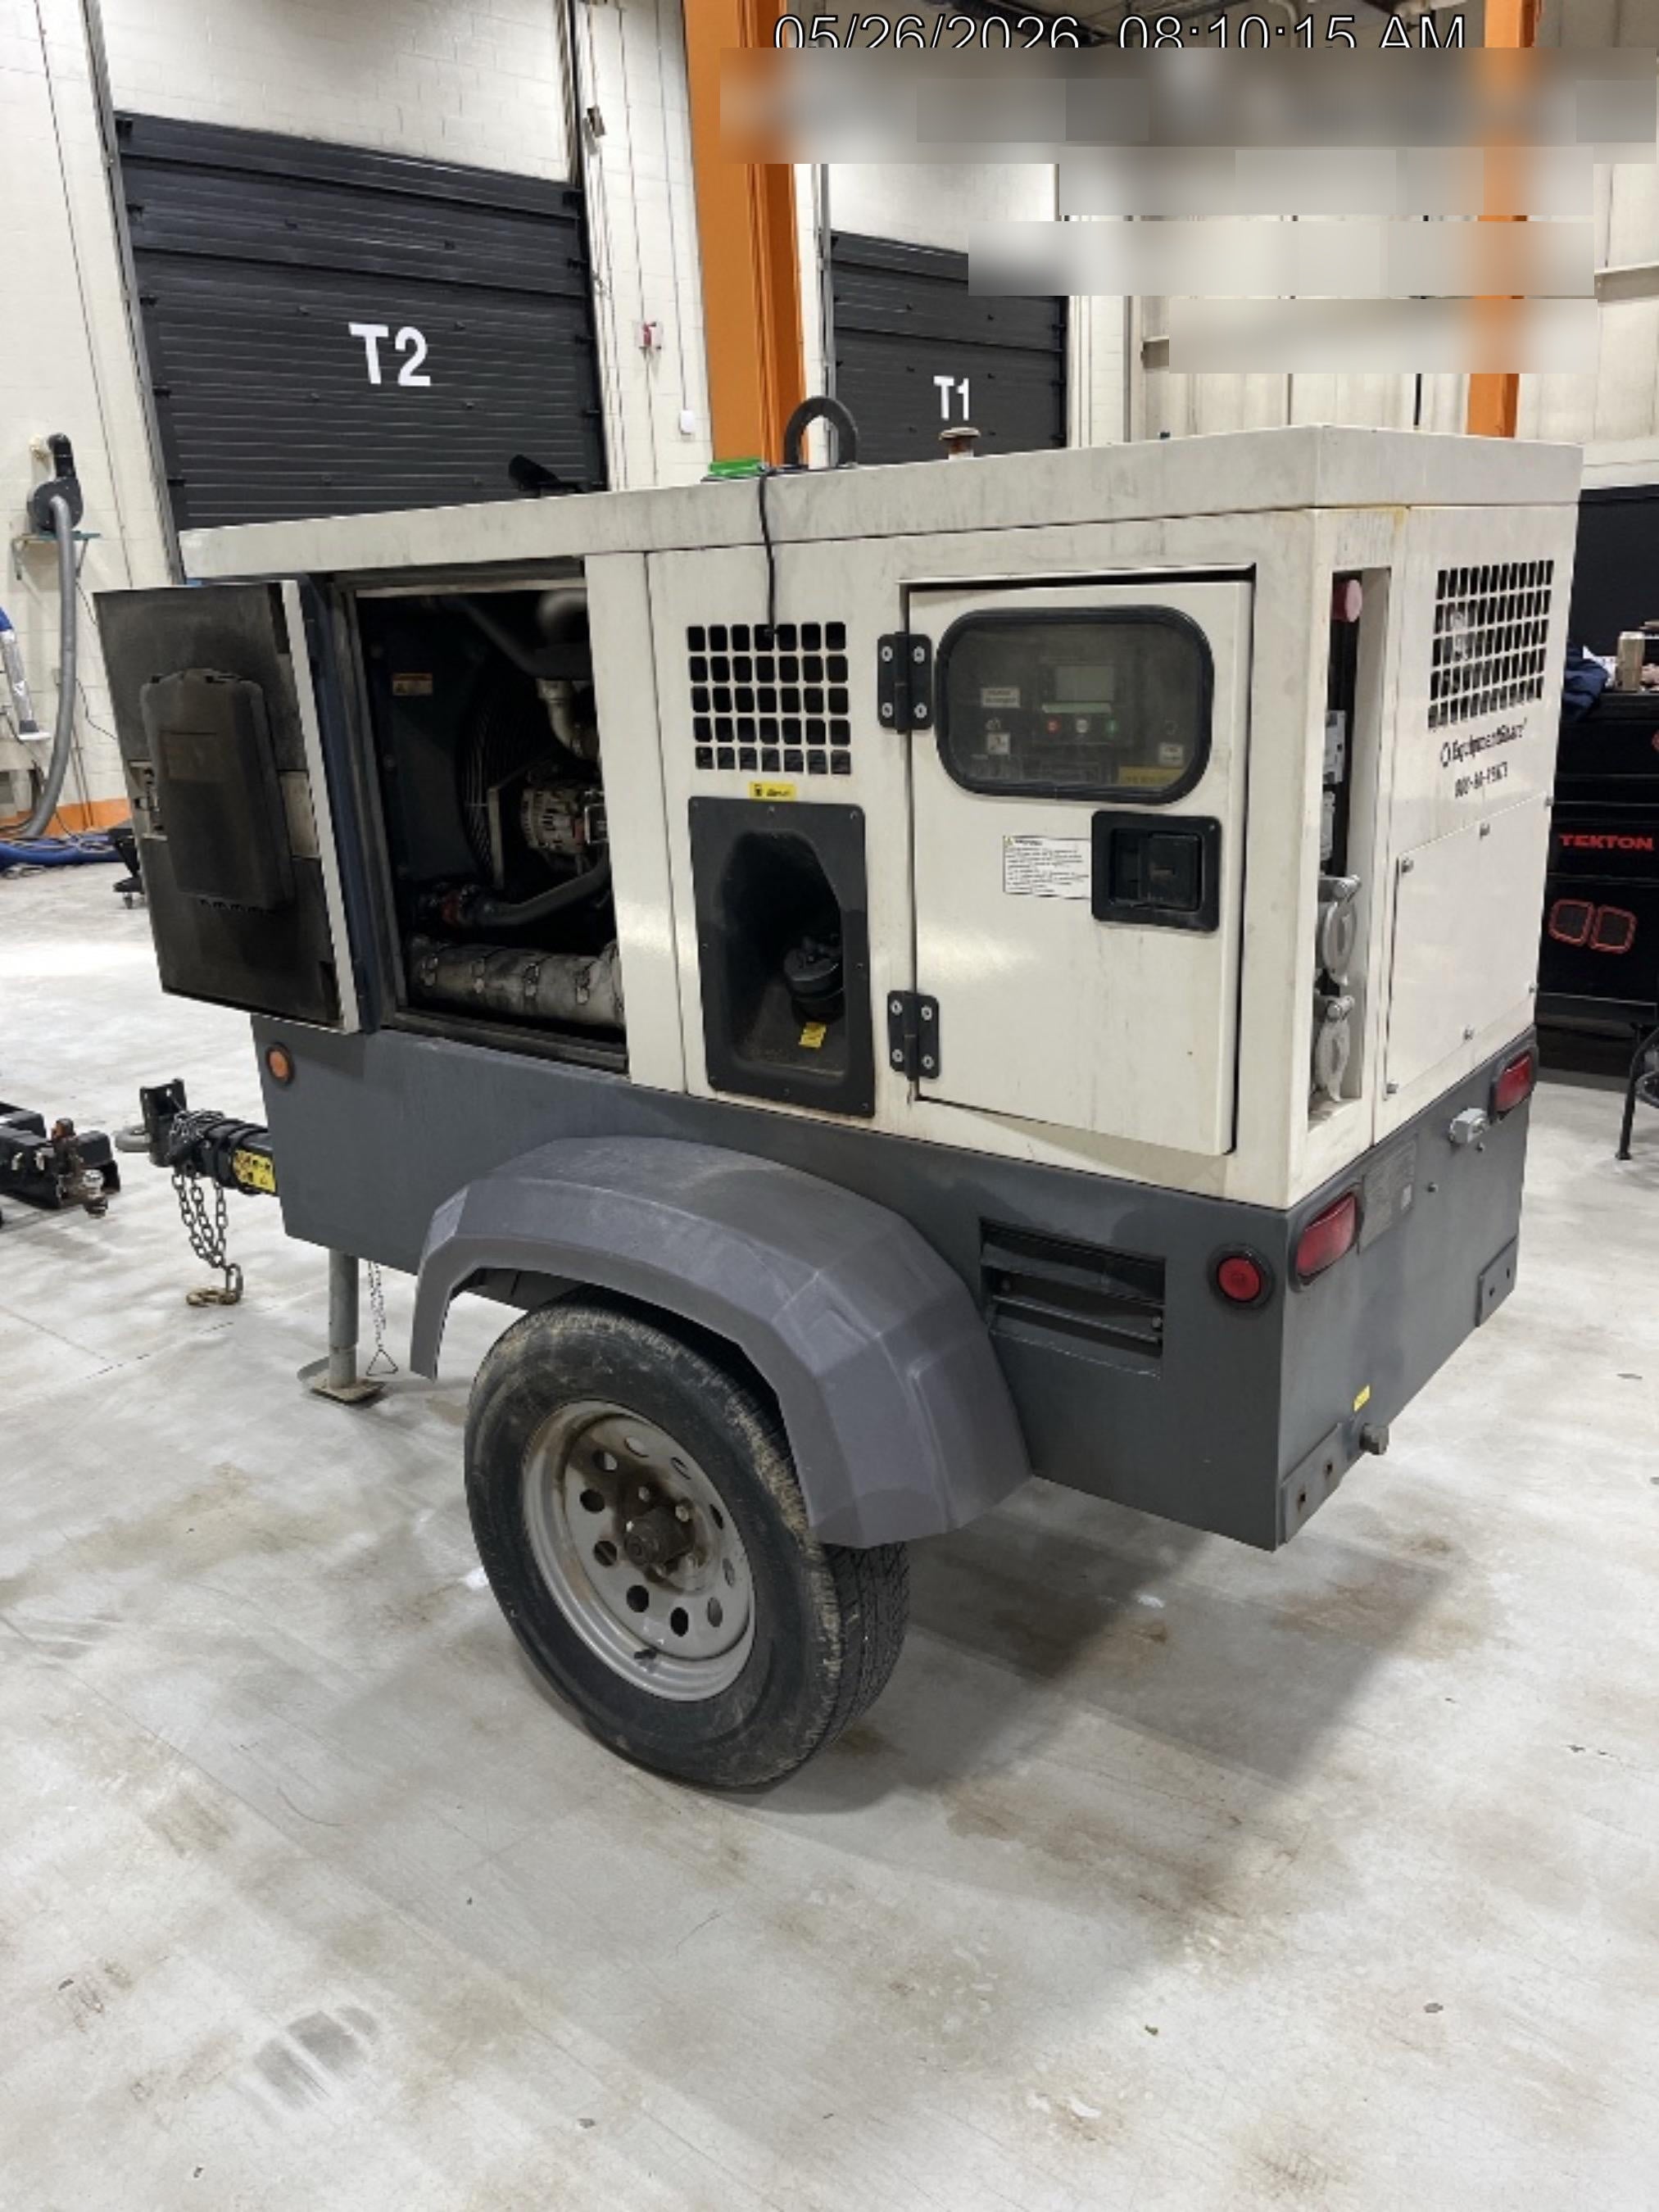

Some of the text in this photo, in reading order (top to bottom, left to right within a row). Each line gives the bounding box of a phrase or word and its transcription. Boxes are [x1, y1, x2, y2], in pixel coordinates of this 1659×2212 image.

[348, 321, 431, 387] T2
[933, 375, 969, 421] T1
[1560, 834, 1654, 850] TEKTON
